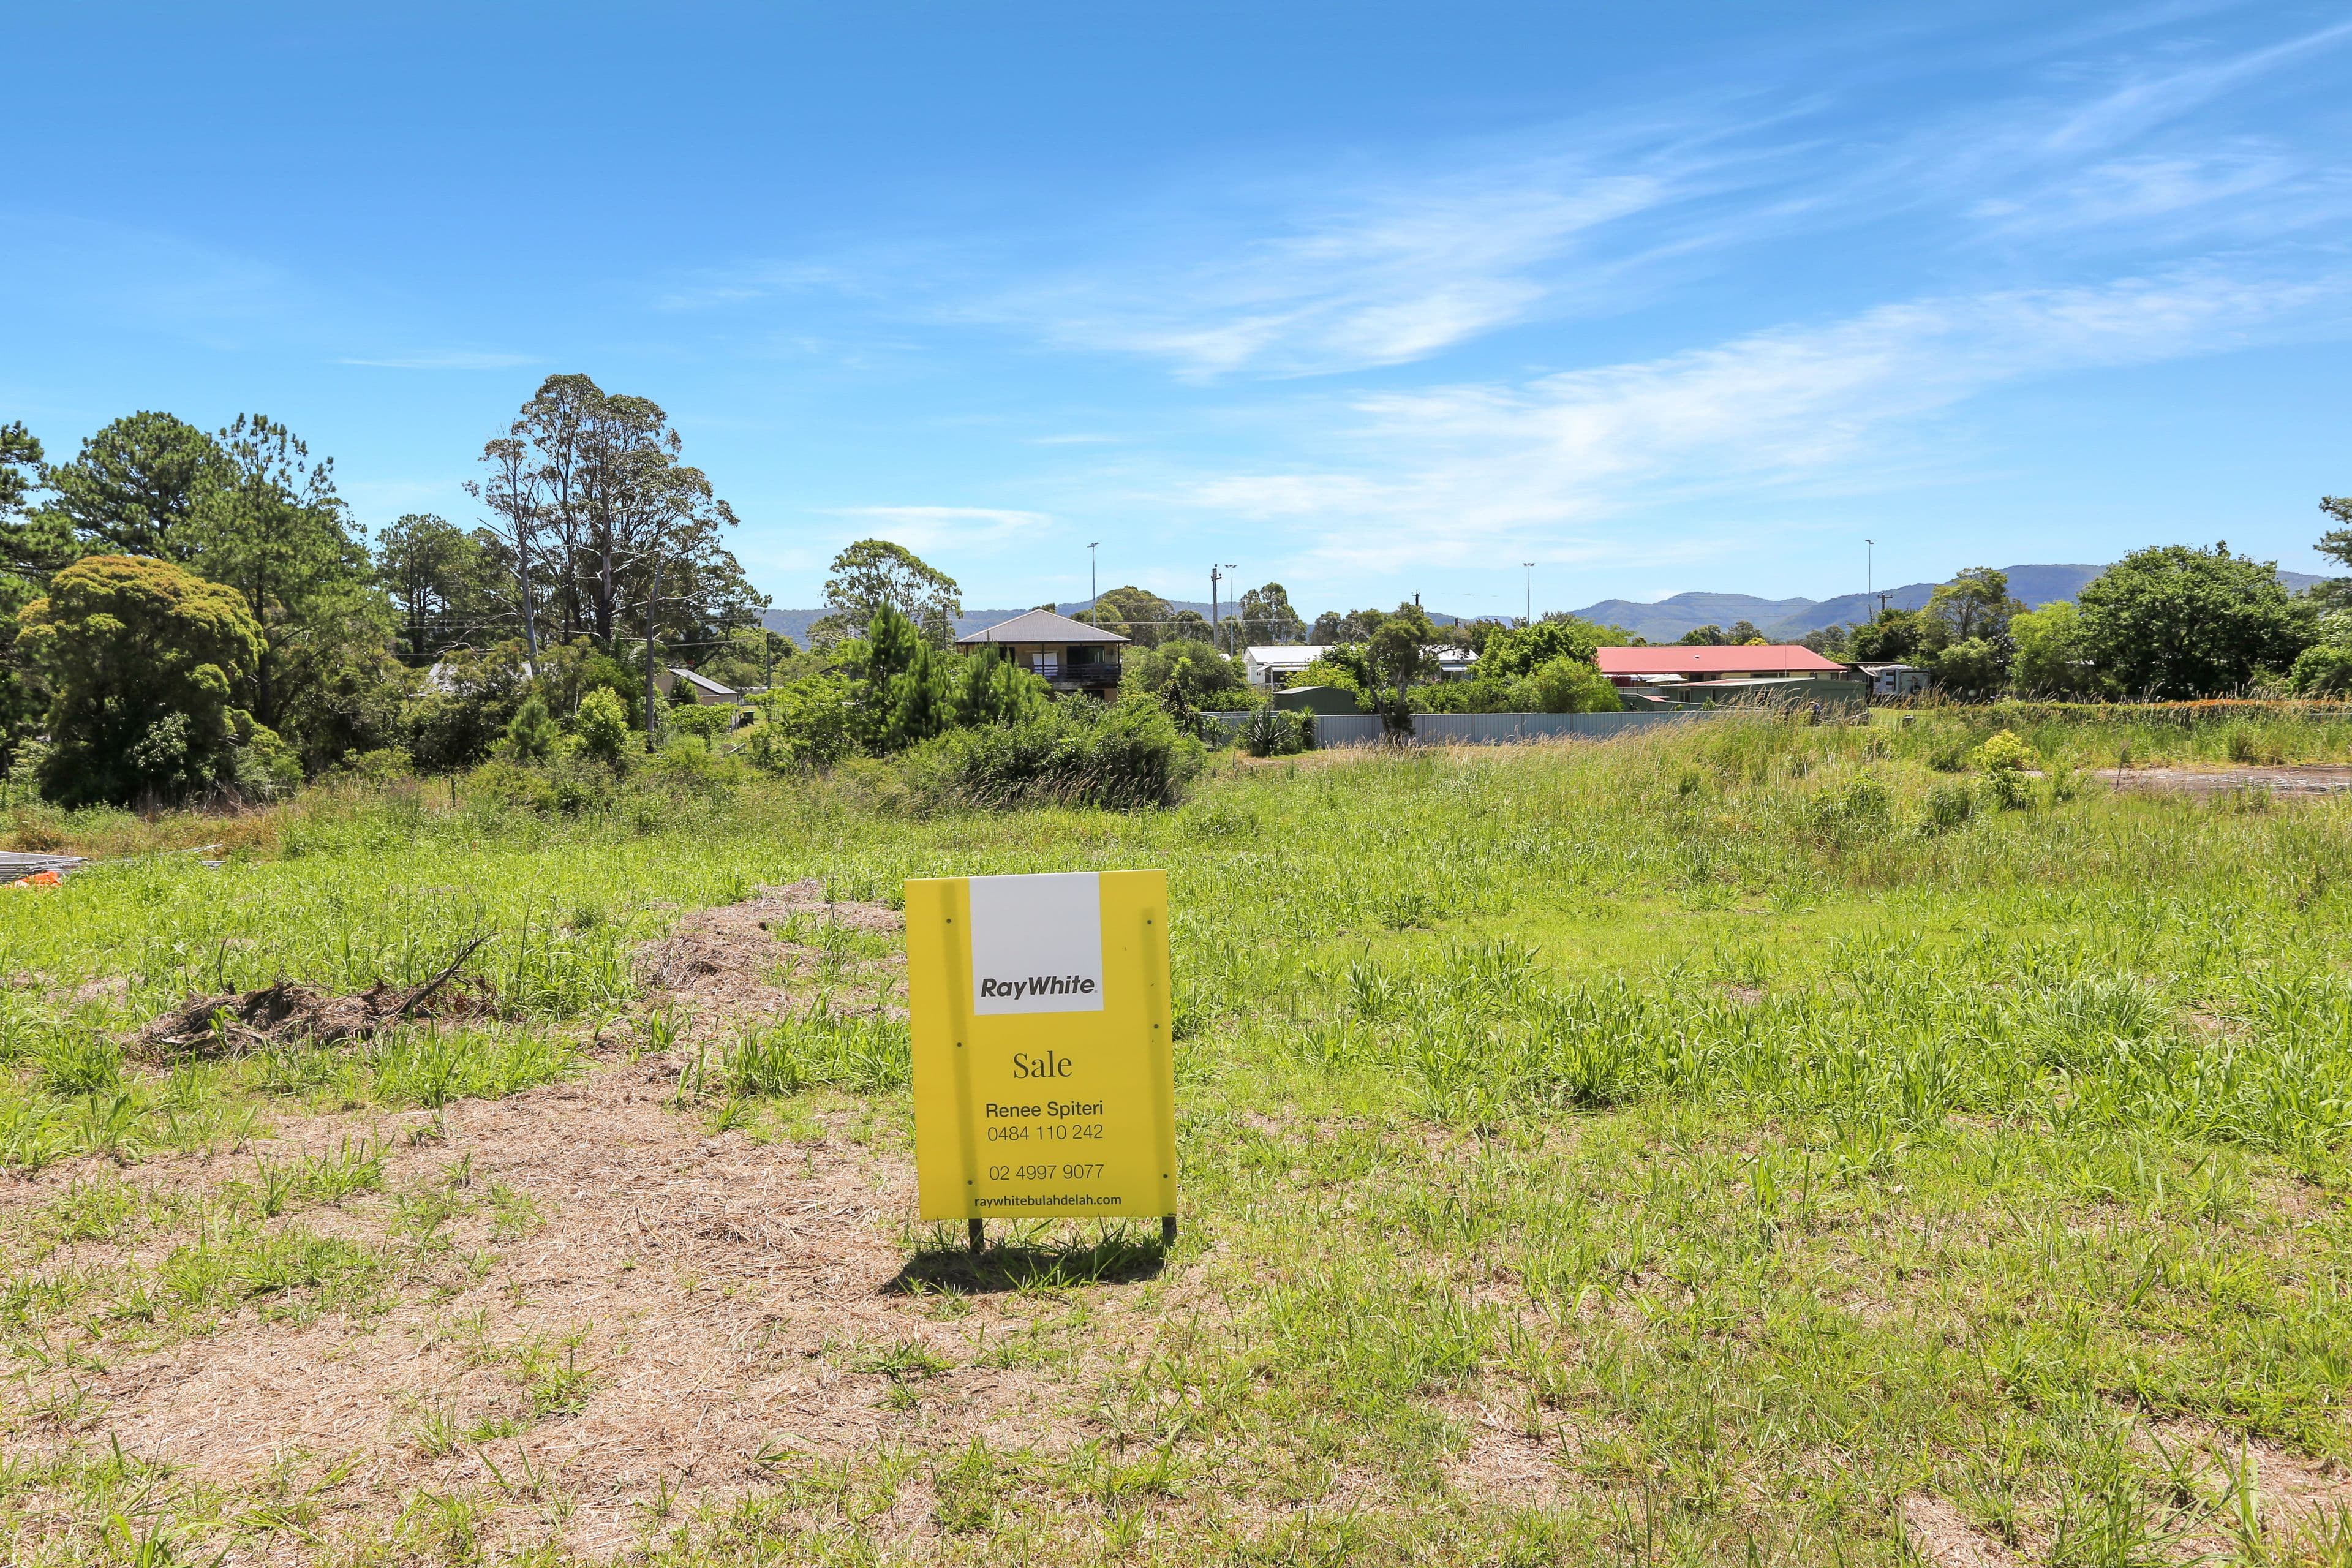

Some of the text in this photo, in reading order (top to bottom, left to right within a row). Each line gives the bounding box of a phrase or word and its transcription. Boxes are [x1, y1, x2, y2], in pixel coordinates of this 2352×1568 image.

[1013, 1050, 1072, 1079] Sale
[986, 1100, 1103, 1120] Renee Spiteri
[987, 1123, 1104, 1142] 0484 110 242
[989, 1164, 1104, 1181] 02 4997 9077
[974, 1194, 1121, 1209] raywhitebulahdelah.com
